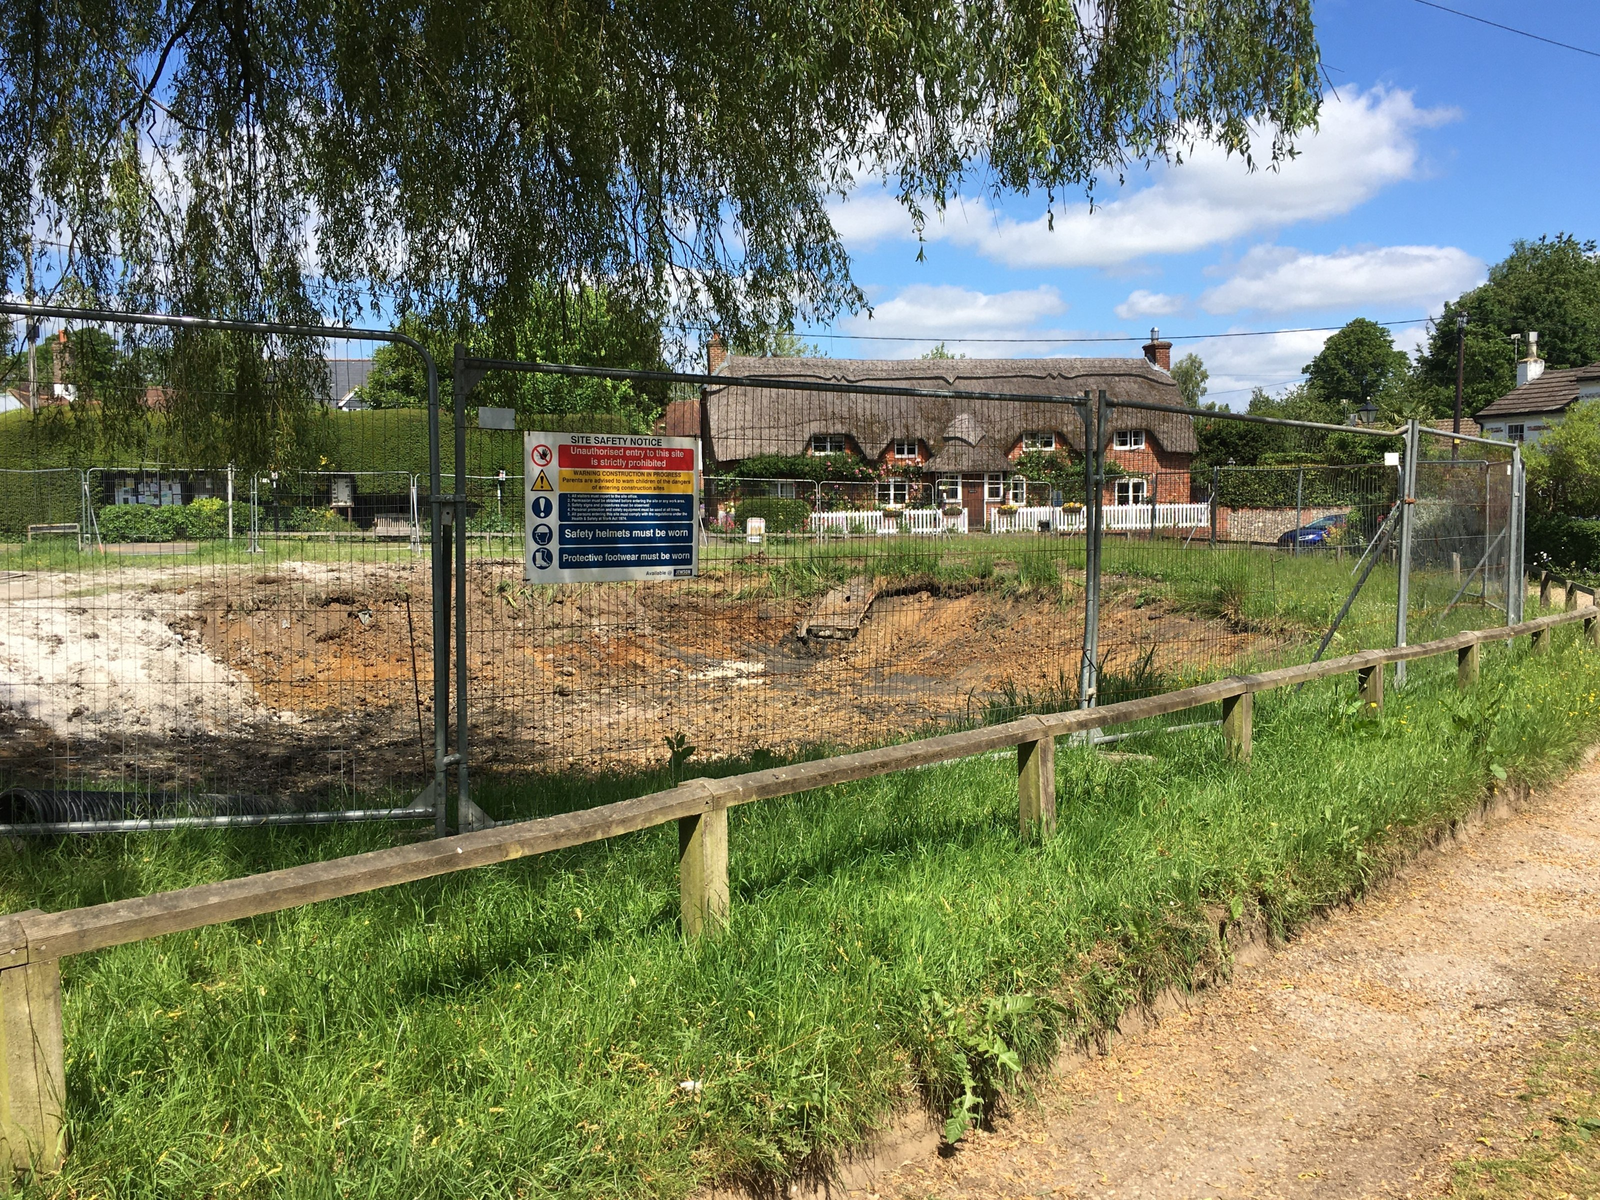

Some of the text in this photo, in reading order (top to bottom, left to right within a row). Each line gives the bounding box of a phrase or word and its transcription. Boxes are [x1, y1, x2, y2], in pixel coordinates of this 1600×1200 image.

[570, 436, 662, 446] SITE SAFETY NOTICE
[570, 446, 624, 456] Unauthorised
[626, 450, 645, 458] entry
[600, 458, 626, 468] strictly
[628, 459, 666, 468] prohibited
[565, 528, 594, 540] Safety
[596, 529, 630, 538] helmets
[632, 529, 654, 537] must
[655, 528, 666, 537] be
[562, 553, 603, 562] Protective
[660, 552, 670, 560] be
